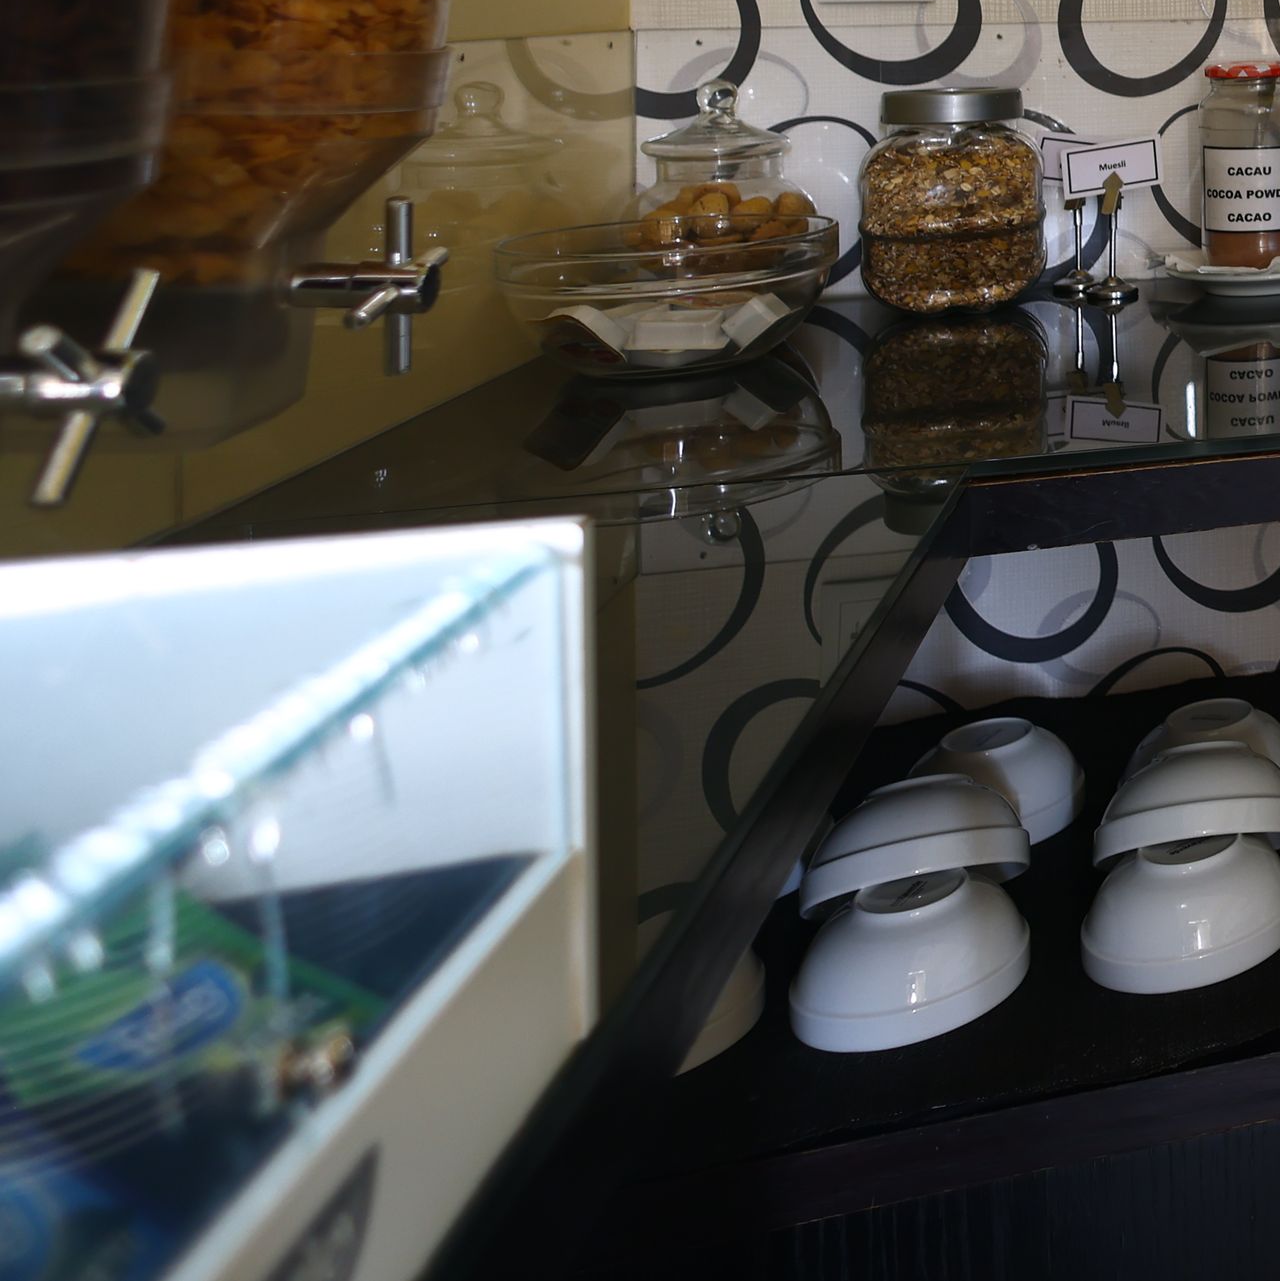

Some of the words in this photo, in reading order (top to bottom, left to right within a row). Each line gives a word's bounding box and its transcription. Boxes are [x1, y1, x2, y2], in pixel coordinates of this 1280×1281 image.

[1098, 160, 1126, 171] Muesli
[1227, 166, 1272, 176] CACAU
[1206, 188, 1242, 199] COCOA
[1227, 212, 1272, 222] CACAO
